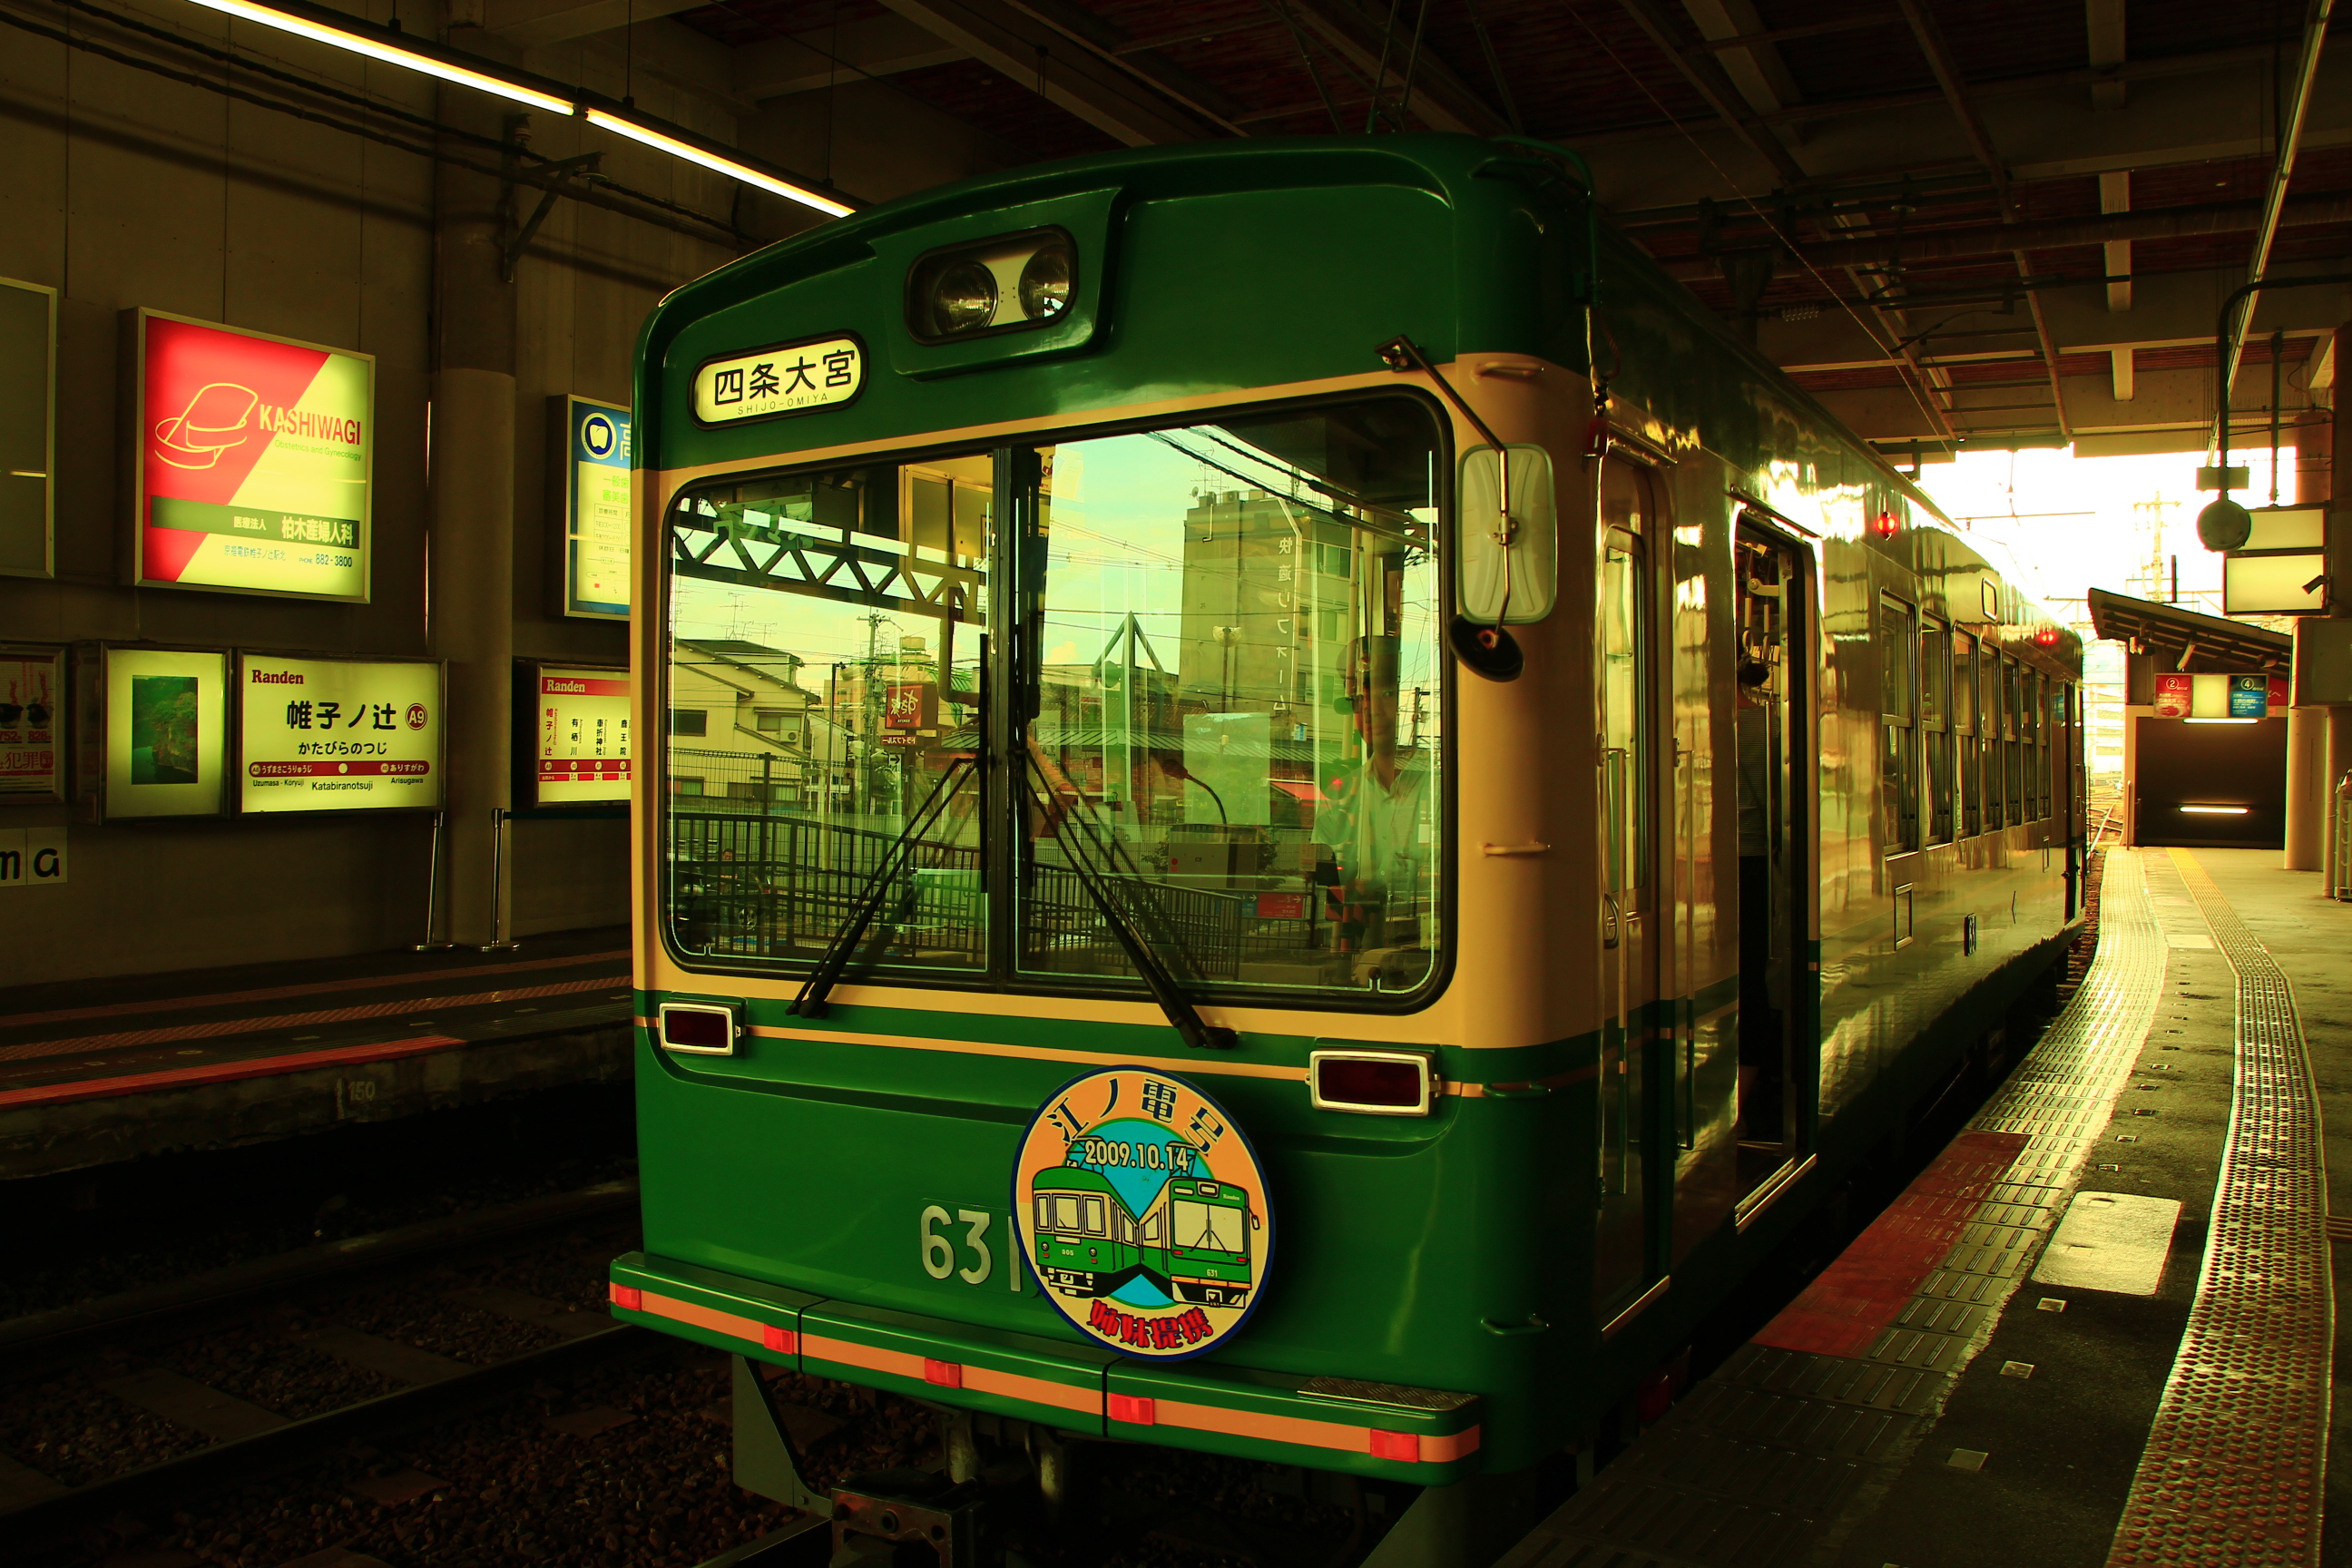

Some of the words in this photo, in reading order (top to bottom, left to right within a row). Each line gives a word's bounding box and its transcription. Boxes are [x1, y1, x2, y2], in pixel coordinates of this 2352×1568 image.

[714, 348, 856, 407] 四条大宮
[737, 392, 828, 416] SHIJO-OMIYA
[260, 403, 361, 446] KASHIWAGI
[274, 439, 309, 453] Obstetrics
[310, 446, 323, 455] and
[324, 446, 361, 461] Gynecology
[233, 515, 267, 531] 医療法人
[281, 515, 354, 545] 柏木産婦人科
[315, 553, 353, 568] 882-3800
[251, 669, 305, 685] Randen
[546, 679, 586, 693] Randen
[287, 700, 397, 730] 帷子ノ辻
[407, 710, 426, 724] A9
[298, 740, 387, 756] かたびらのつじ
[261, 764, 313, 774] うずまさこうりゅうじ
[390, 763, 425, 772] ありすがわ
[311, 780, 374, 791] Katabiranotsuji
[390, 777, 424, 785] Arisugawa
[348, 1081, 376, 1102] 150
[1046, 1077, 1225, 1154] 江ノ電号
[1084, 1140, 1190, 1171] 2009.10.14
[919, 1204, 1022, 1293] 631
[1206, 1269, 1218, 1278] 631
[1087, 1298, 1214, 1350] 姉妹提携
